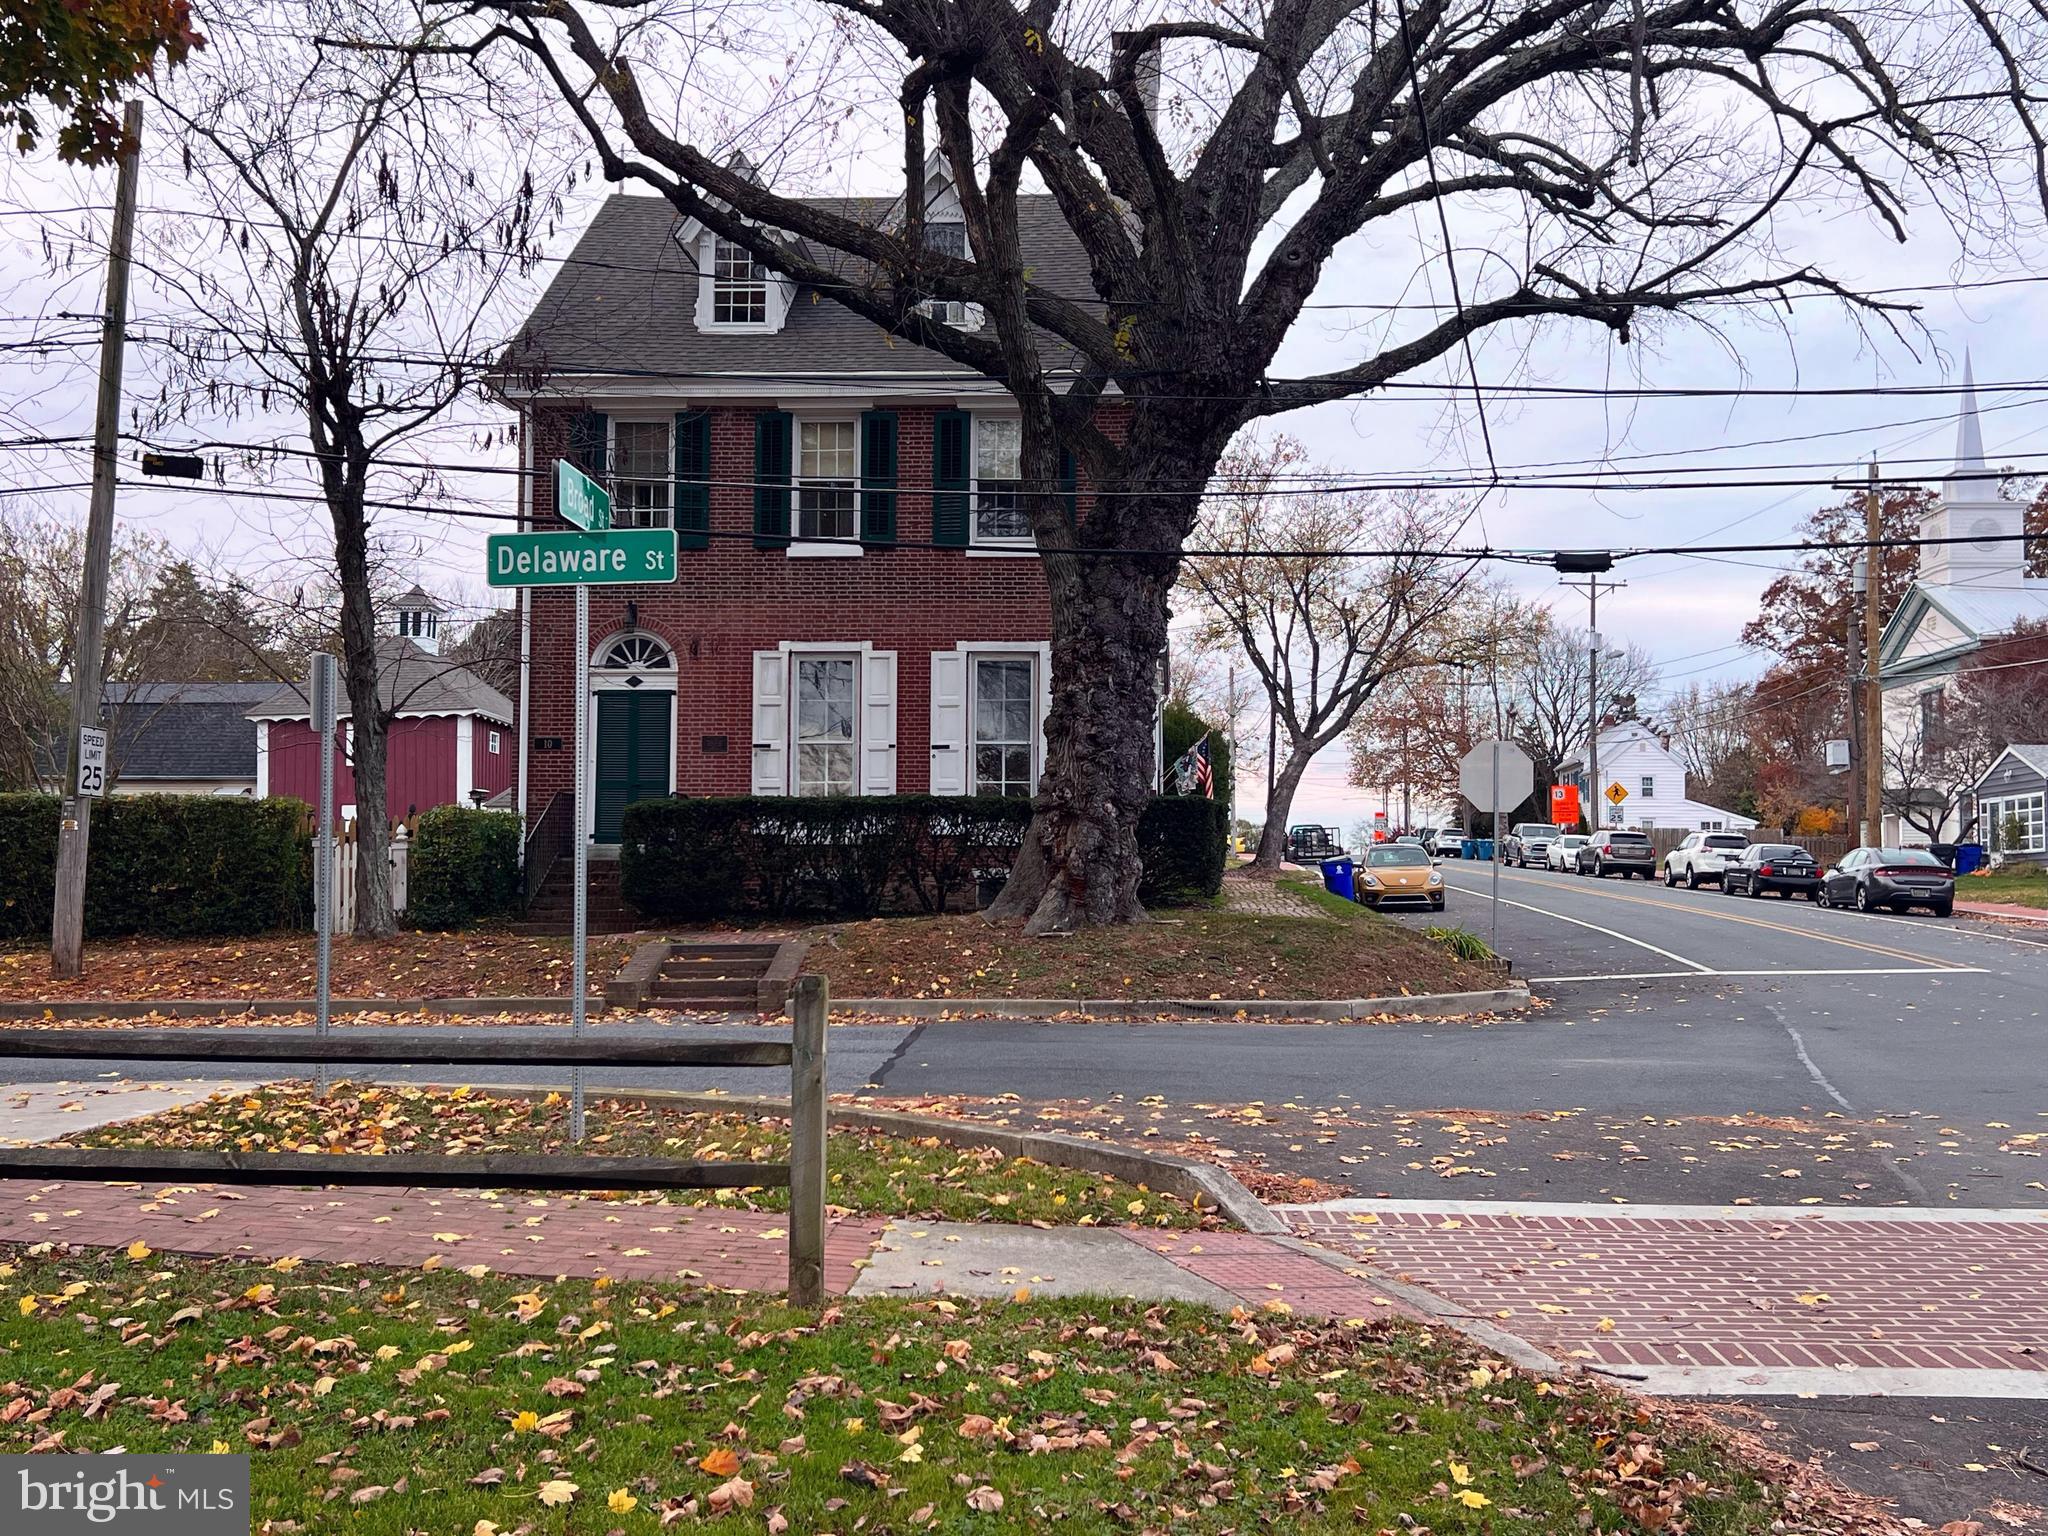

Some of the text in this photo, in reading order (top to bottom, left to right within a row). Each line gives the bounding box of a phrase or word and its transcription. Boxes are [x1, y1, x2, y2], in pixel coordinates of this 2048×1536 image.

[567, 479, 606, 529] Broad St
[497, 545, 665, 575] Delaware St
[83, 734, 105, 748] SPEED
[544, 739, 553, 749] 10
[84, 749, 102, 761] LIMIT
[81, 765, 102, 791] 25
[1555, 790, 1563, 799] 13
[1610, 814, 1623, 822] 25
